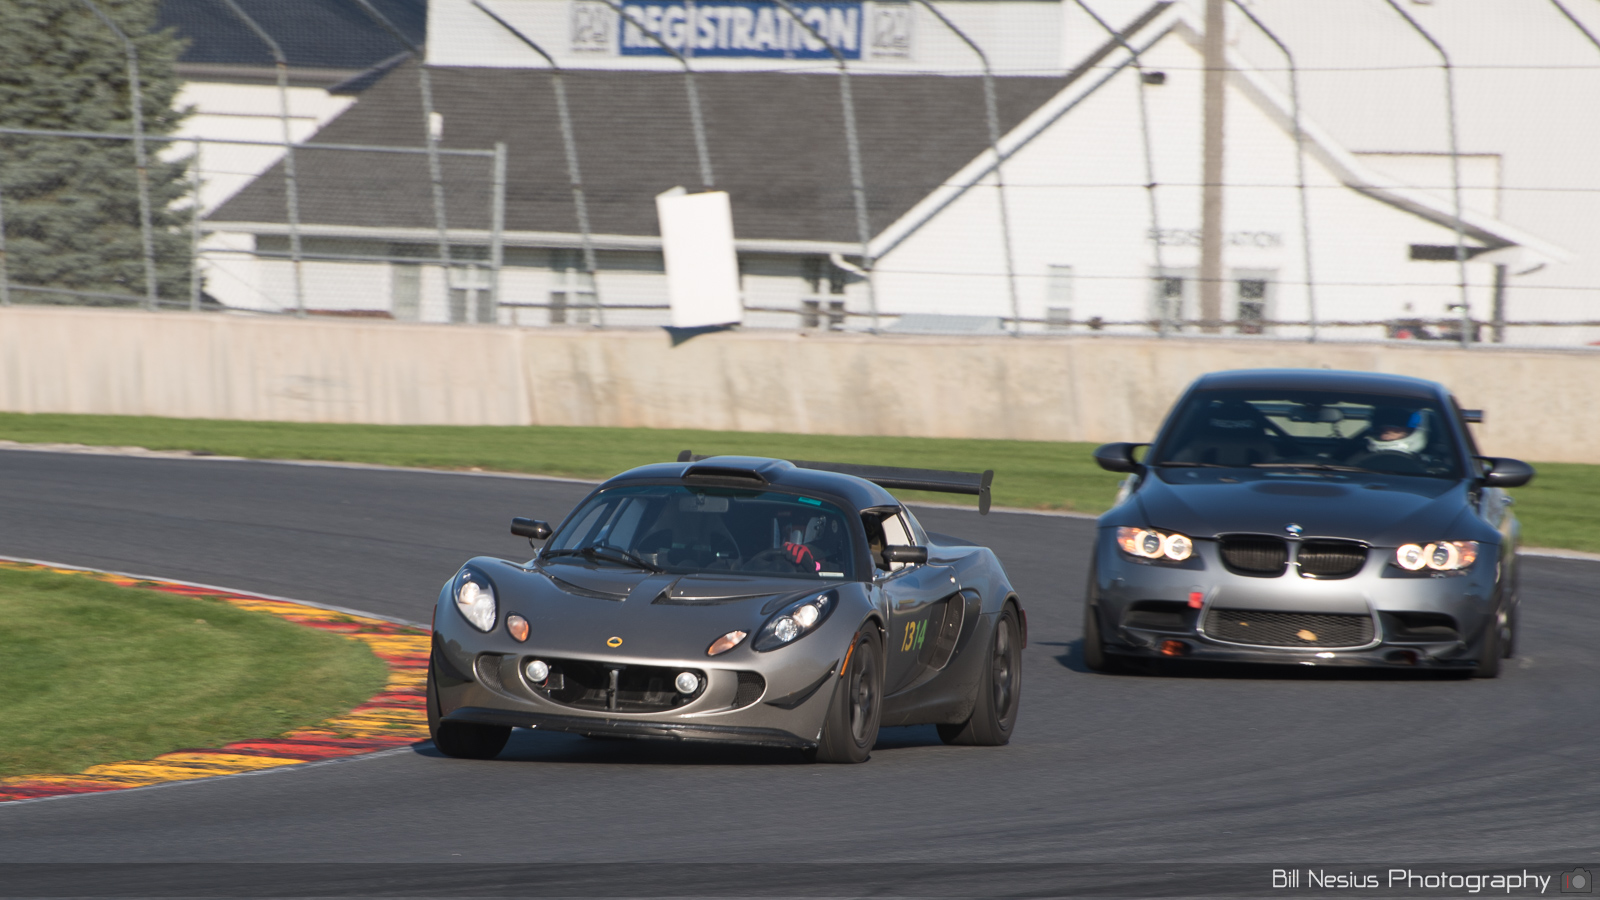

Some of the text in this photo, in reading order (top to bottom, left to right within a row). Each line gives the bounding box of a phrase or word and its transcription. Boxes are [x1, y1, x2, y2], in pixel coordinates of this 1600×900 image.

[623, 5, 859, 51] REGISTRATION
[1147, 228, 1284, 248] REGISATION
[901, 619, 928, 652] 1314
